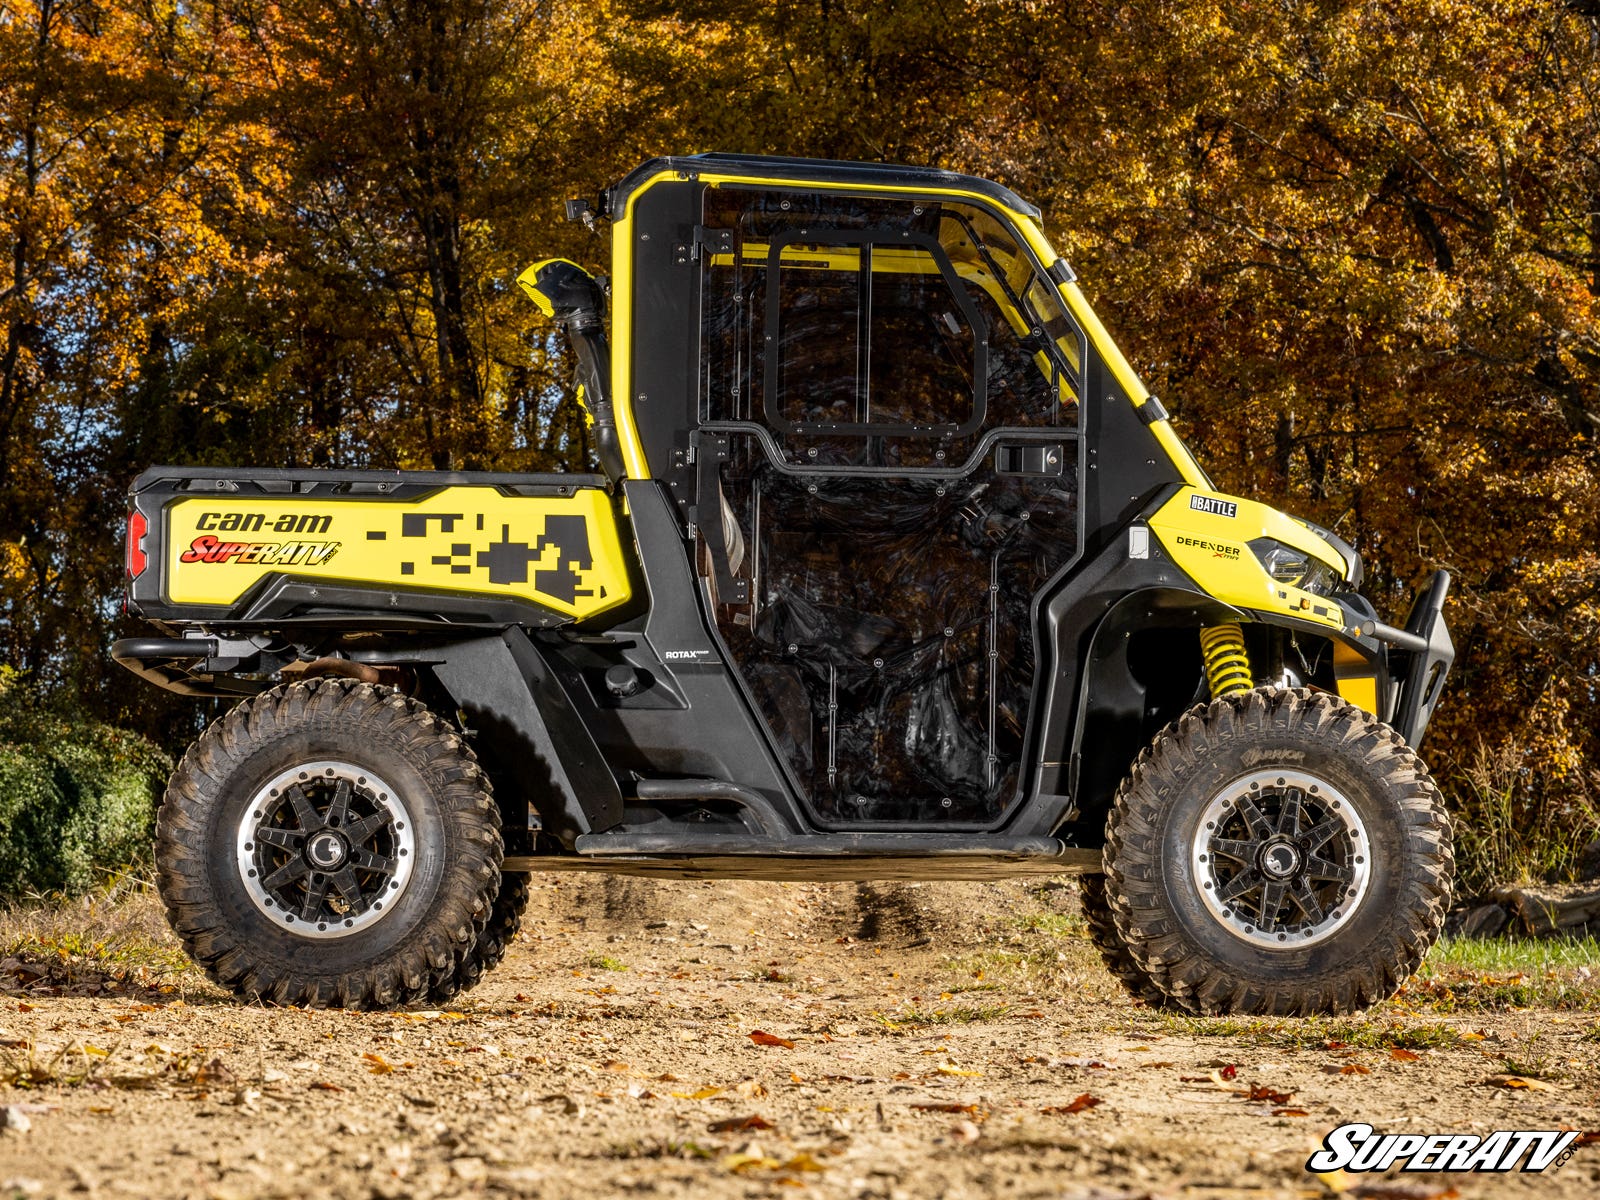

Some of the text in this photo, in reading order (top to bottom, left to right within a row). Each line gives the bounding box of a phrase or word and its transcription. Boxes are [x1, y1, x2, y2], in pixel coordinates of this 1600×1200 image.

[196, 513, 333, 533] can-am
[1176, 536, 1241, 556] DEFENDER
[665, 651, 697, 659] ROTAX
